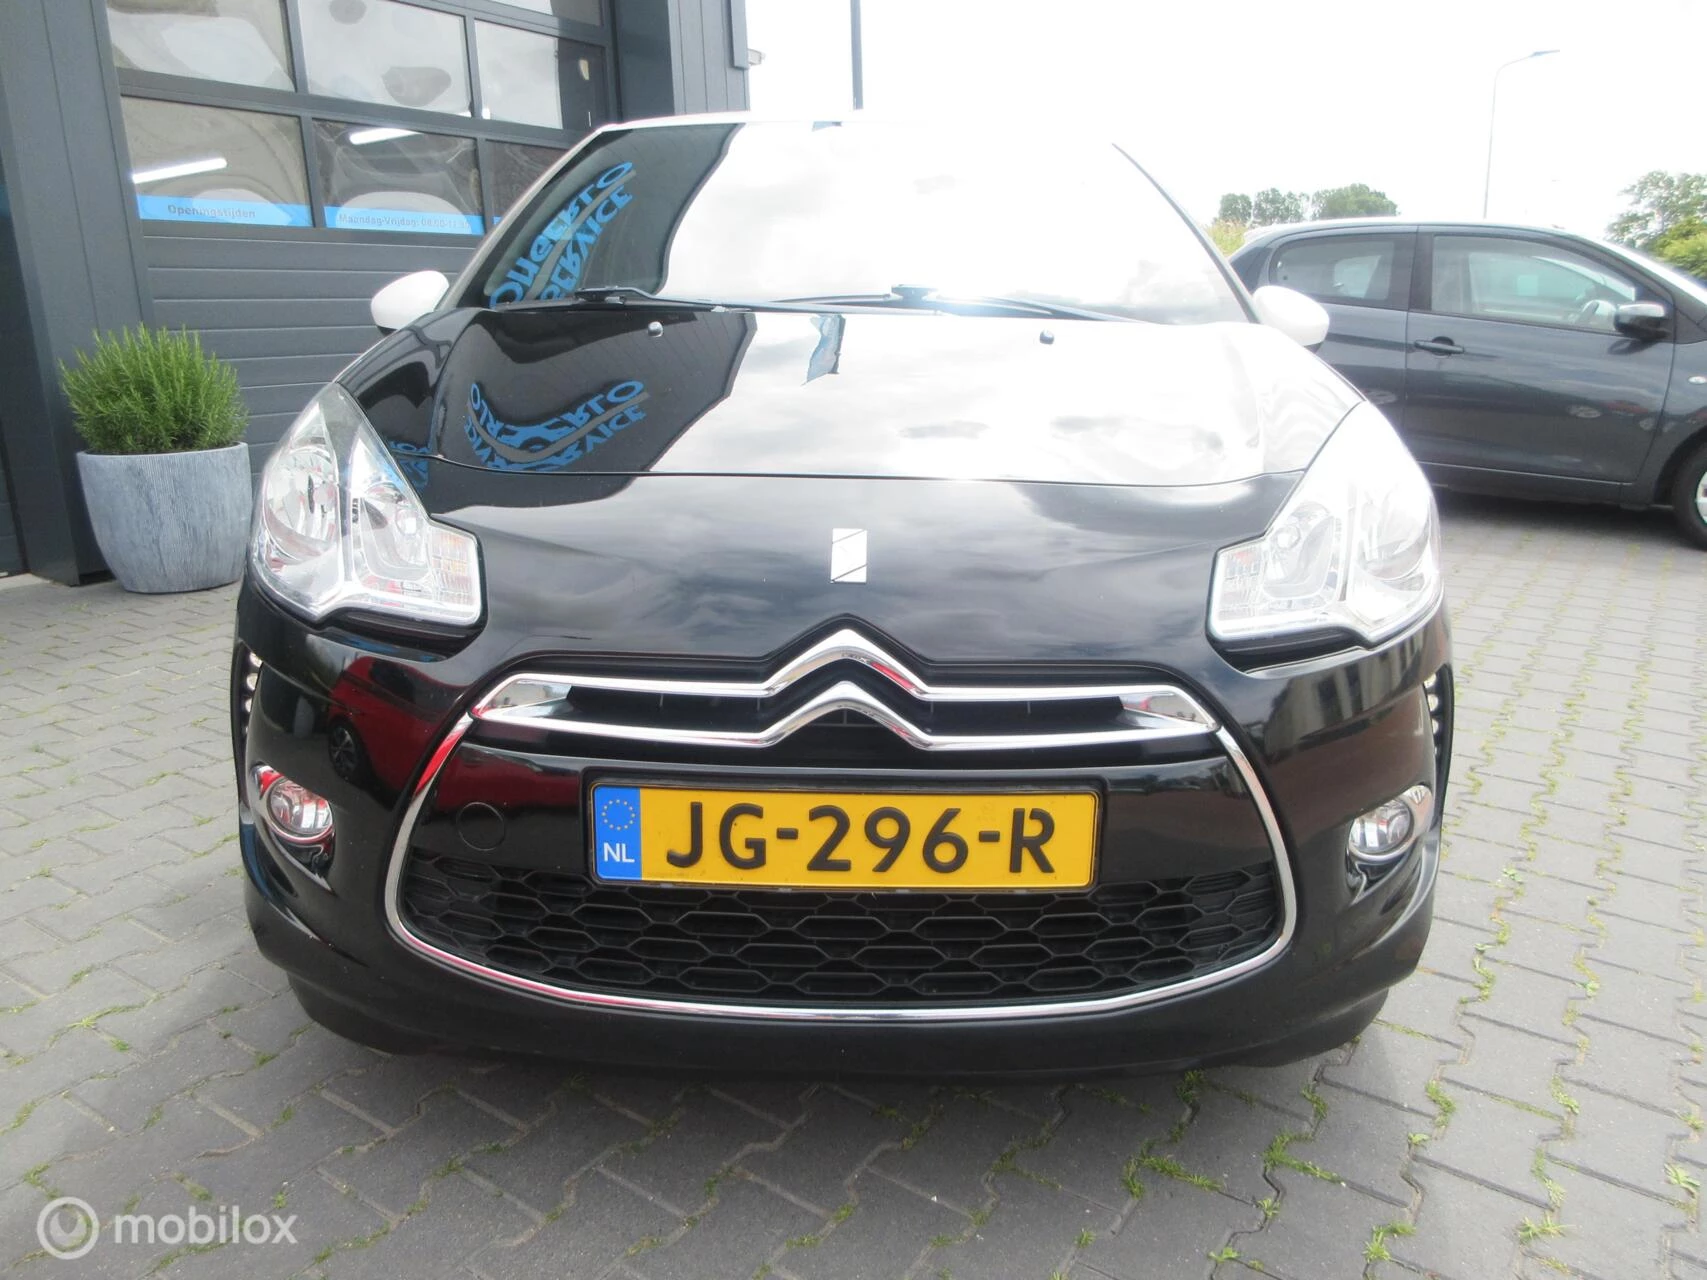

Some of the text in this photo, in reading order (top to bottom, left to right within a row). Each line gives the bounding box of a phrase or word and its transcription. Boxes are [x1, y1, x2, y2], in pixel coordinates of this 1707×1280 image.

[167, 204, 256, 219] Openingstijden
[666, 801, 1056, 875] JG-296-R
[602, 842, 635, 864] NL
